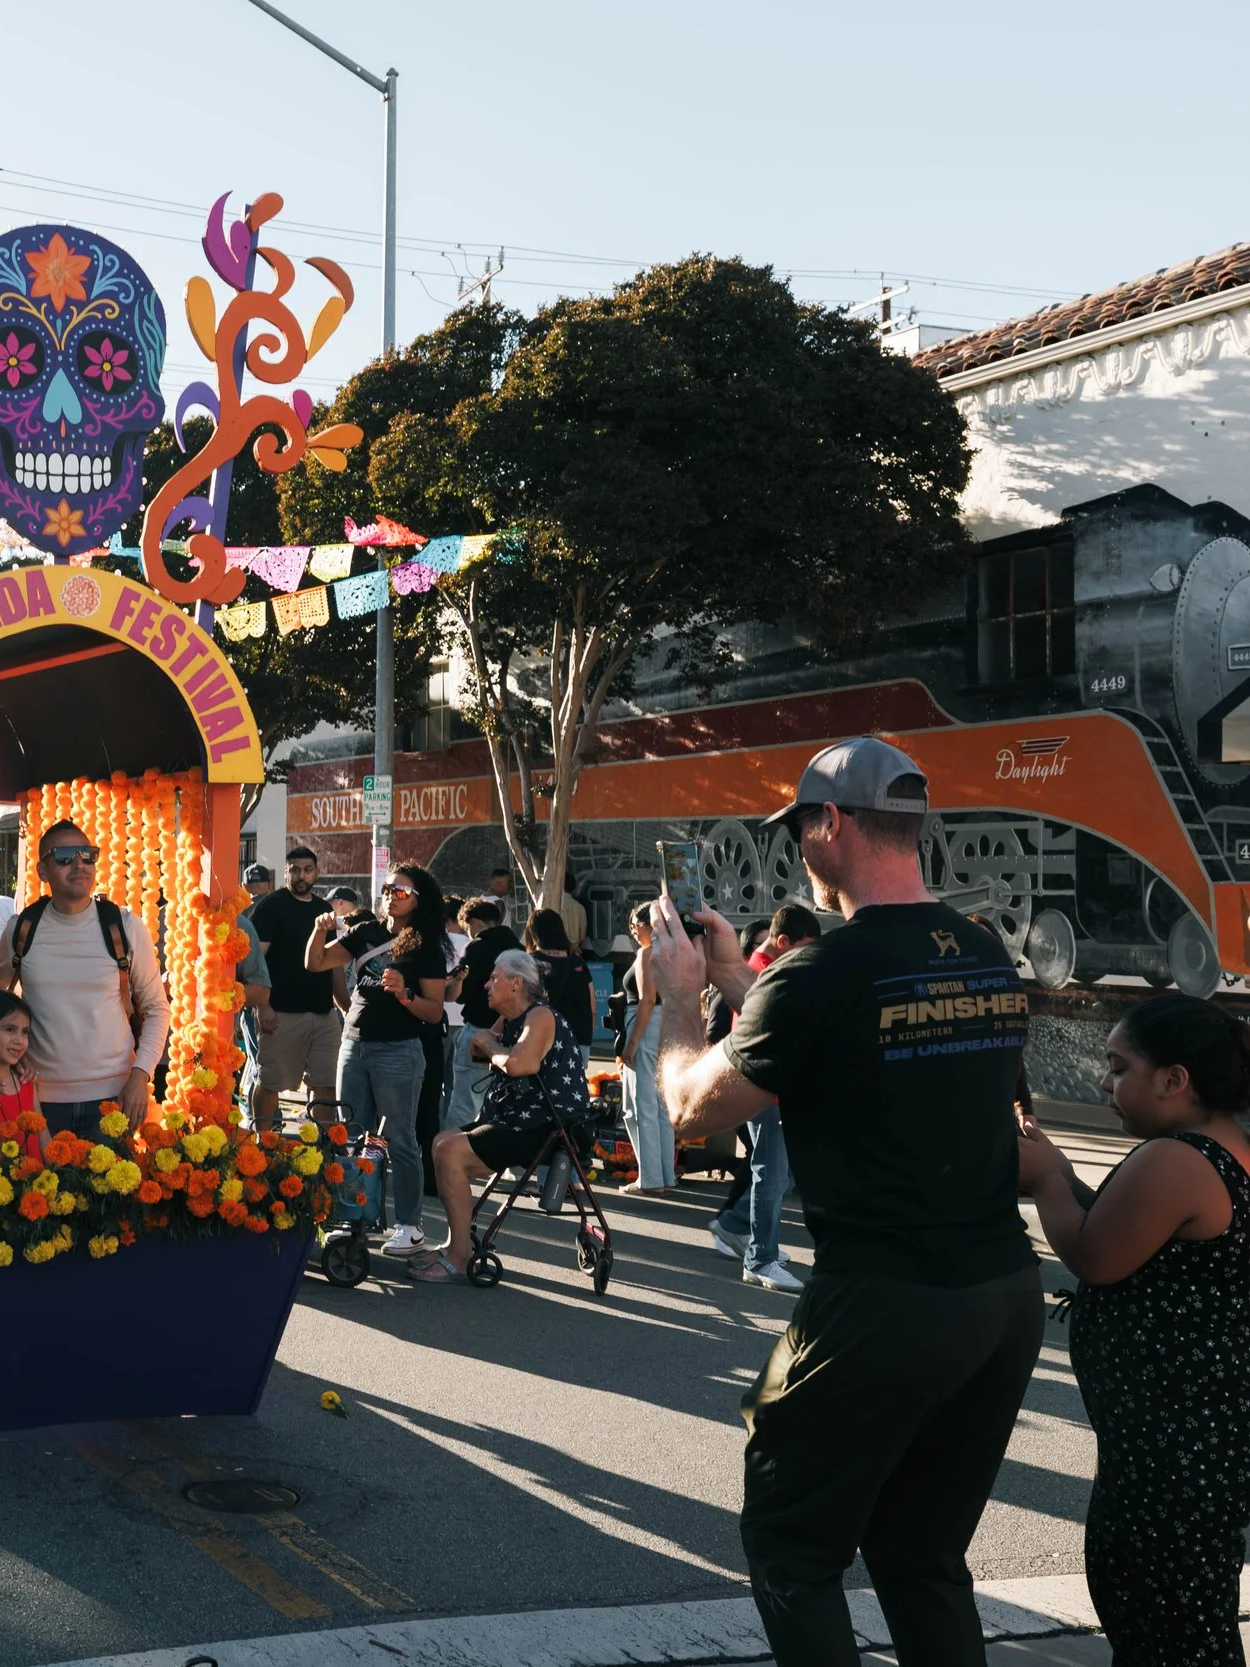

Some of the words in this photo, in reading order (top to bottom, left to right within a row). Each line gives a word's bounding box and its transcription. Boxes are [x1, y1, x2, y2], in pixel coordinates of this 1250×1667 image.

[1233, 652, 1250, 662] 444
[110, 587, 251, 763] FESTIVAL
[1091, 675, 1126, 692] 4449
[996, 749, 1072, 784] Daylight
[365, 778, 373, 789] 2
[375, 780, 390, 789] HOUR
[365, 792, 391, 801] PARKING
[312, 795, 364, 828] SOUTH
[400, 785, 467, 821] PACIFIC
[927, 980, 965, 995] SPARTAN
[967, 977, 1008, 991] SUPER
[879, 992, 1029, 1029] FINISHER
[878, 1035, 892, 1044] 10
[898, 1026, 953, 1041] KILOMETERS
[884, 1048, 914, 1061] BE
